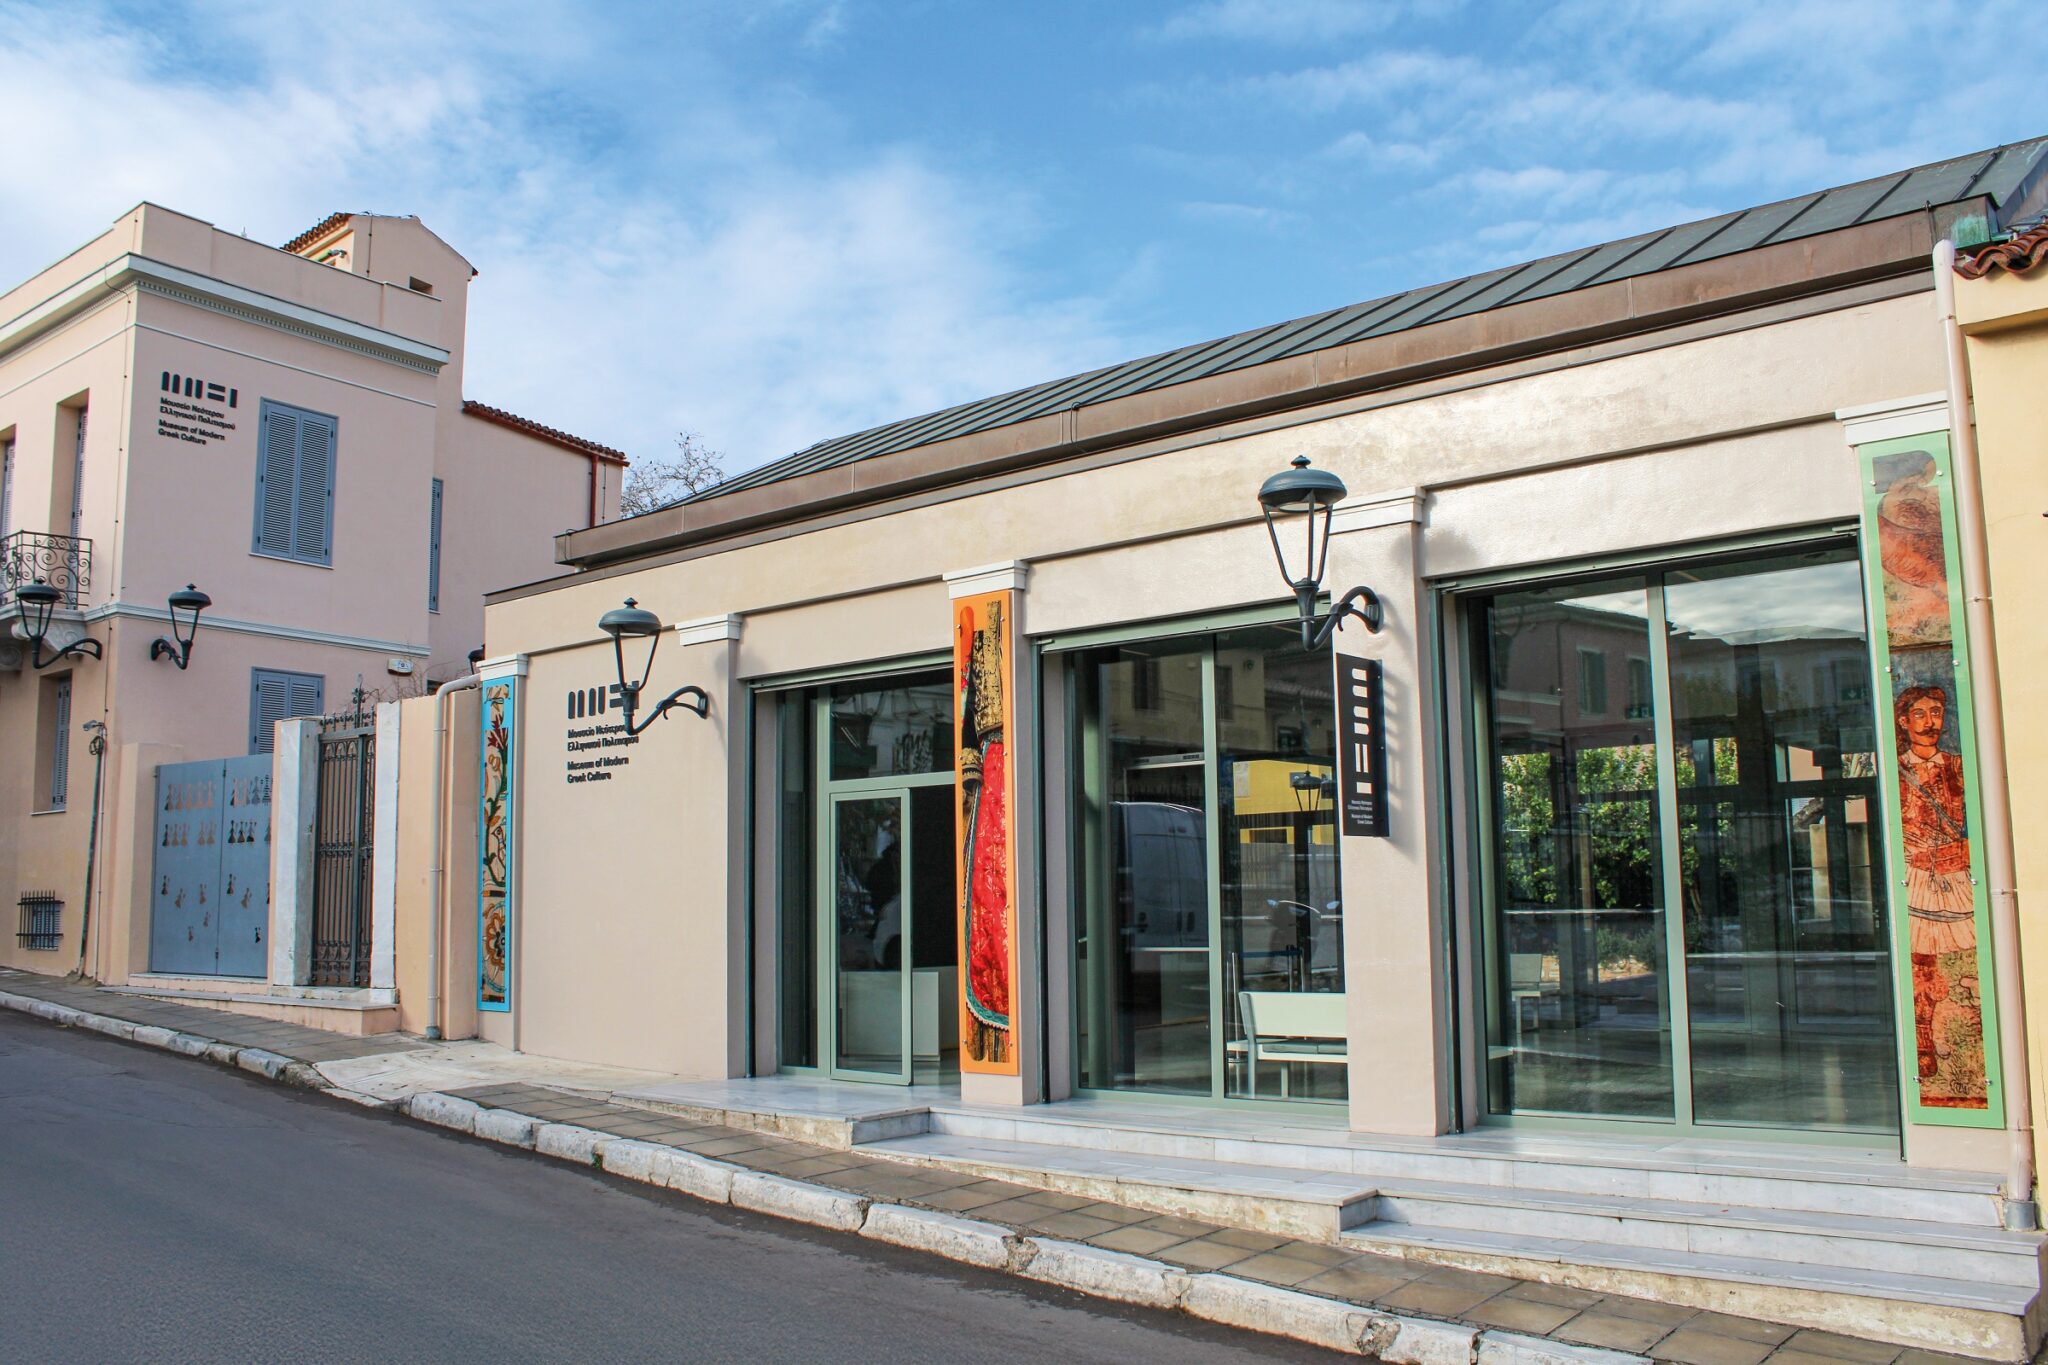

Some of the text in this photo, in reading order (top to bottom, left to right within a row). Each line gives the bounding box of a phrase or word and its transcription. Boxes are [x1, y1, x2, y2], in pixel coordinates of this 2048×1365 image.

[158, 428, 207, 445] Greek Culture
[159, 419, 226, 441] Museum of Modern
[567, 756, 629, 771] Museum of Modern
[567, 771, 612, 783] Greek Culture
